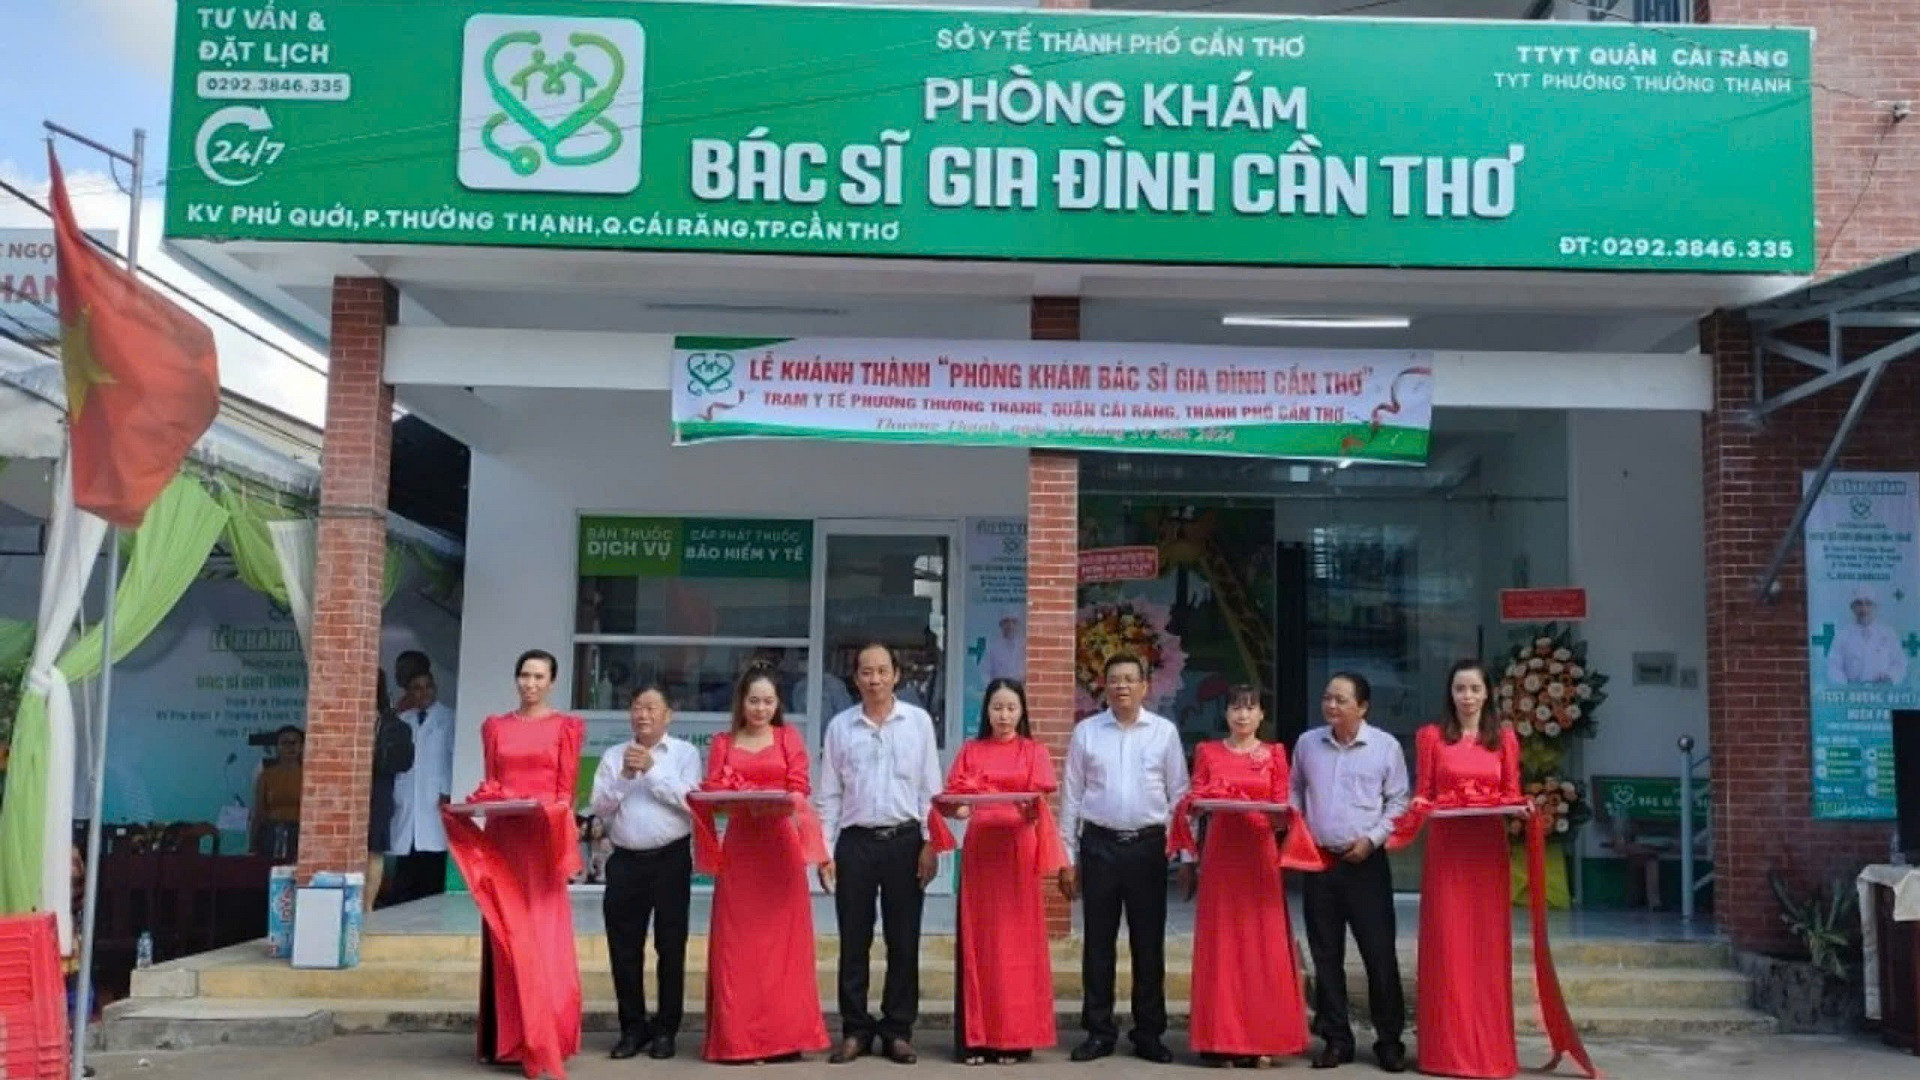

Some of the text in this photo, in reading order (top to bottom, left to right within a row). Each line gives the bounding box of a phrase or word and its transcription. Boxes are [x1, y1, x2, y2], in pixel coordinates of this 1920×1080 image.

[198, 0, 327, 32] TƯ VẤN &
[198, 35, 330, 69] ĐẶT LỊCH
[937, 22, 974, 50] SỞ
[978, 30, 998, 47] Y
[1001, 23, 1033, 50] TẾ
[1039, 29, 1121, 53] THÀNH
[1128, 27, 1182, 55] PHỐ
[1252, 36, 1306, 58] THƠ
[1517, 42, 1790, 72] TTYT QUẬN CÁI RĂNG
[924, 64, 1309, 130] PHÒNG KHÁM
[1493, 72, 1791, 99] TYT PHƯỜNG THƯỜNG THẠNH
[212, 135, 286, 167] 24/7
[691, 126, 1526, 217] BÁC SĨ GIA ĐÌNH CẦN THƠ
[188, 204, 224, 223] KV
[231, 201, 281, 225] PHÚ
[849, 221, 899, 241] THƠ
[749, 351, 774, 381] LỄ
[781, 356, 854, 385] KHÁNH
[860, 357, 931, 388] THÀNH
[1028, 360, 1091, 390] KHÁM
[1097, 360, 1139, 392] BÁC
[1147, 361, 1169, 393] SĨ
[1175, 369, 1210, 394] GIA
[1216, 364, 1267, 395] ĐÌNH
[812, 393, 823, 408] Y
[588, 541, 671, 562] DỊCH VỤ
[768, 548, 779, 561] Y
